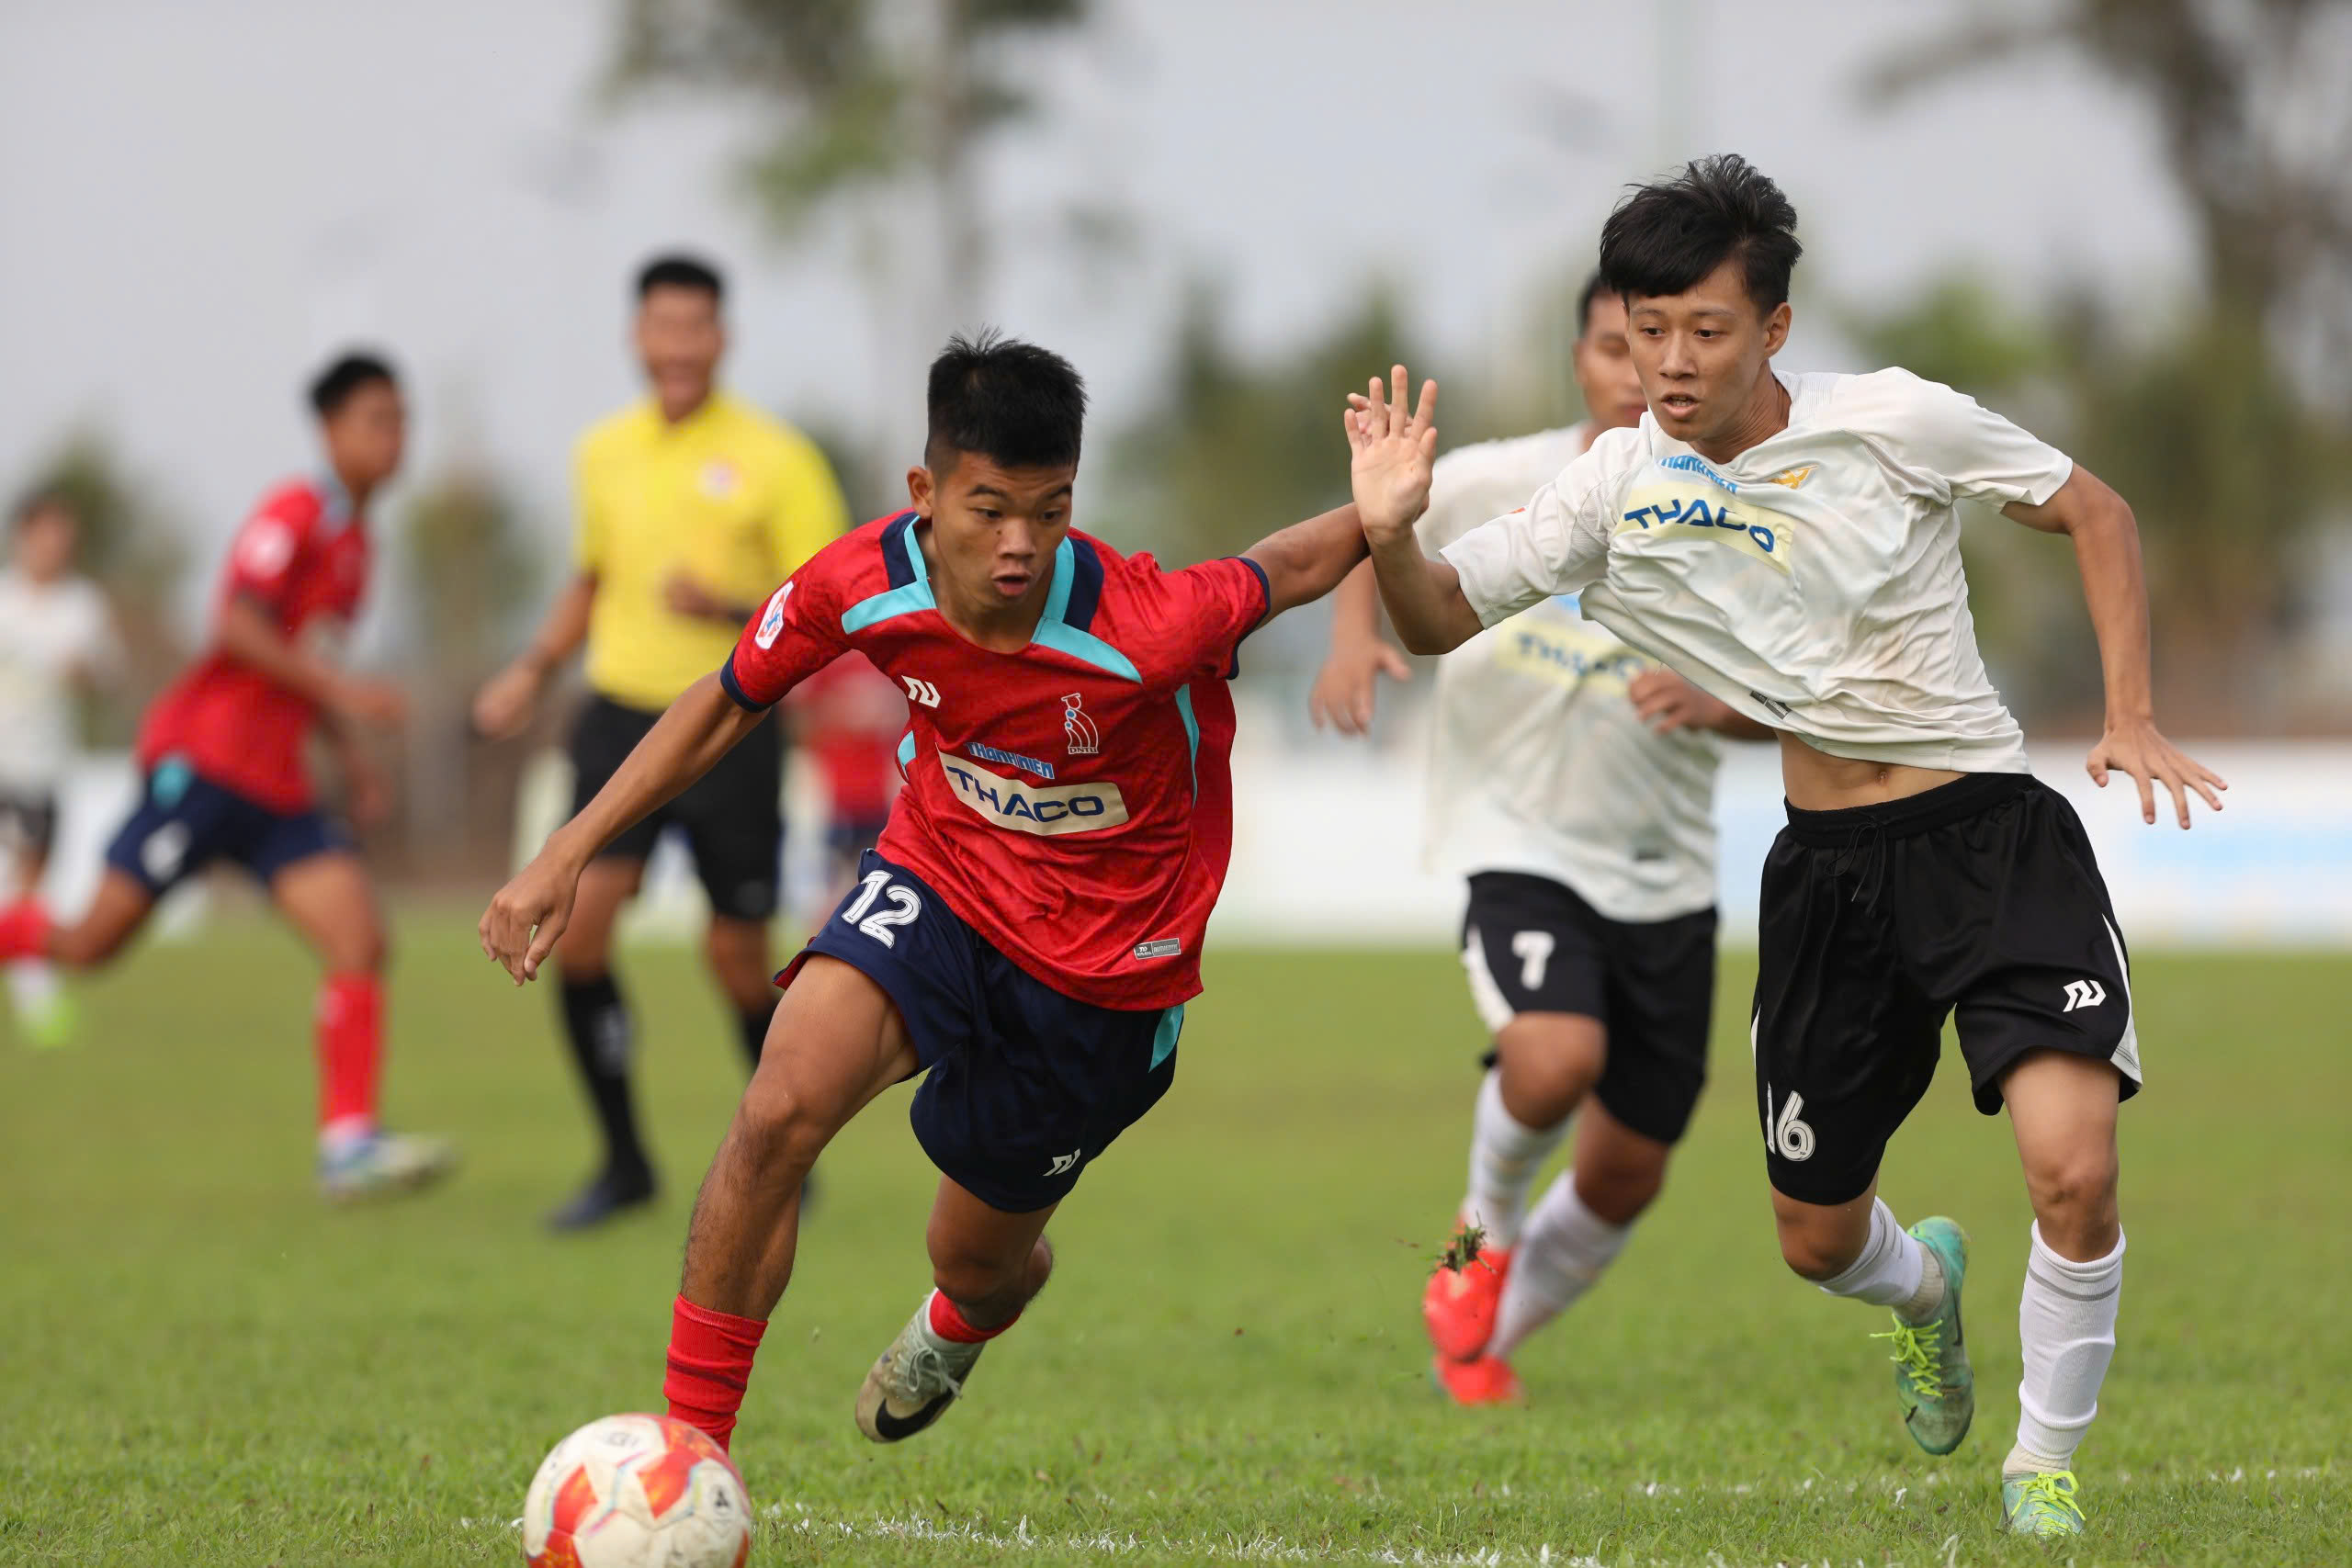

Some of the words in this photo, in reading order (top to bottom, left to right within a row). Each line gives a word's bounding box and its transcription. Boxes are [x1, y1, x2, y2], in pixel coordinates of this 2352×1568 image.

[1623, 499, 1775, 553] THACO
[946, 765, 1104, 823] THACO
[842, 869, 922, 949] 12
[1512, 931, 1555, 989] 7
